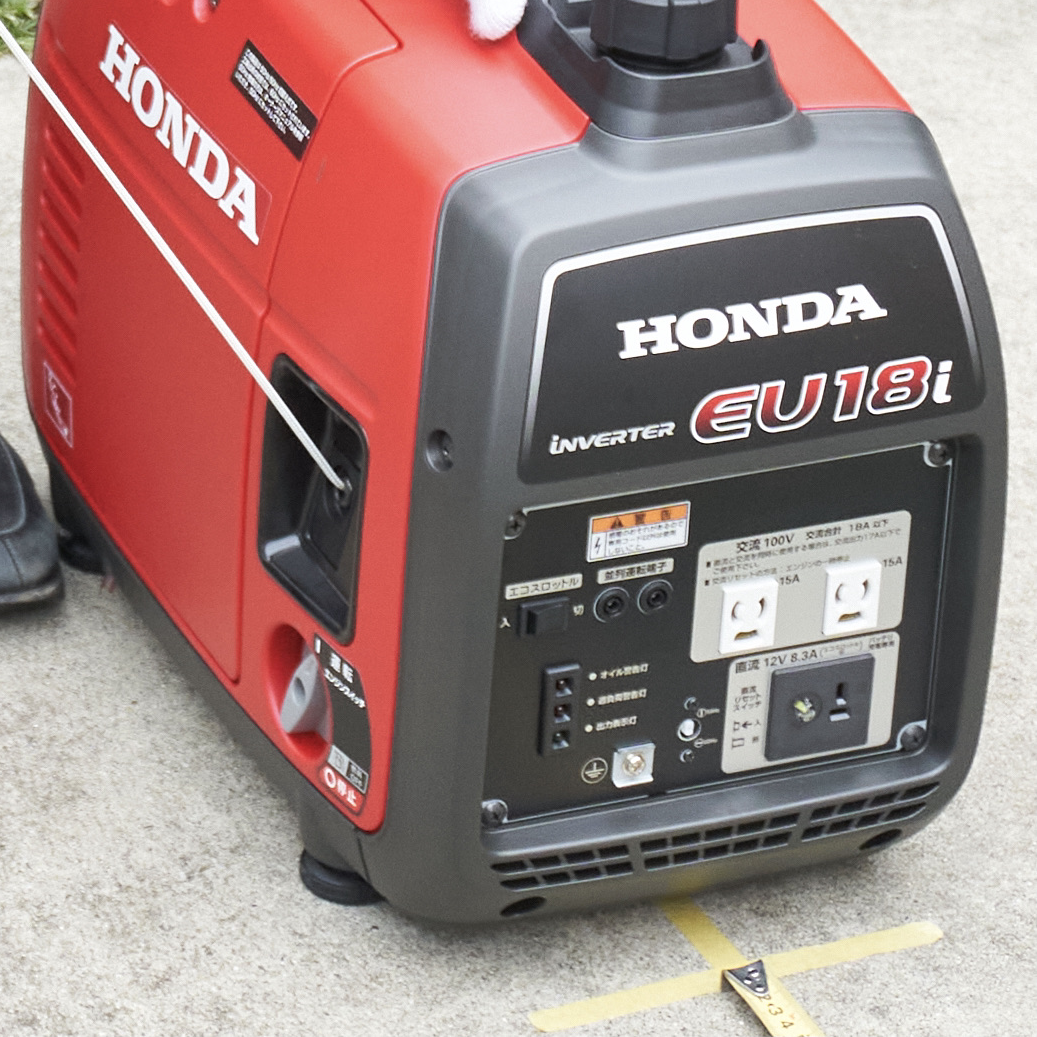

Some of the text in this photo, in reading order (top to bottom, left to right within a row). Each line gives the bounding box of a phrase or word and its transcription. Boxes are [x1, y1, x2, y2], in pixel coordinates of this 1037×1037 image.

[99, 23, 260, 246] HONDA
[617, 283, 888, 360] HONDA
[690, 355, 953, 445] EU18i
[736, 538, 761, 554] 交流
[764, 533, 795, 548] 100V
[883, 556, 902, 568] 15A
[509, 577, 579, 598] エコスロットル
[779, 574, 800, 586] 15A
[763, 654, 787, 668] 12V
[790, 649, 818, 663] 8.3A
